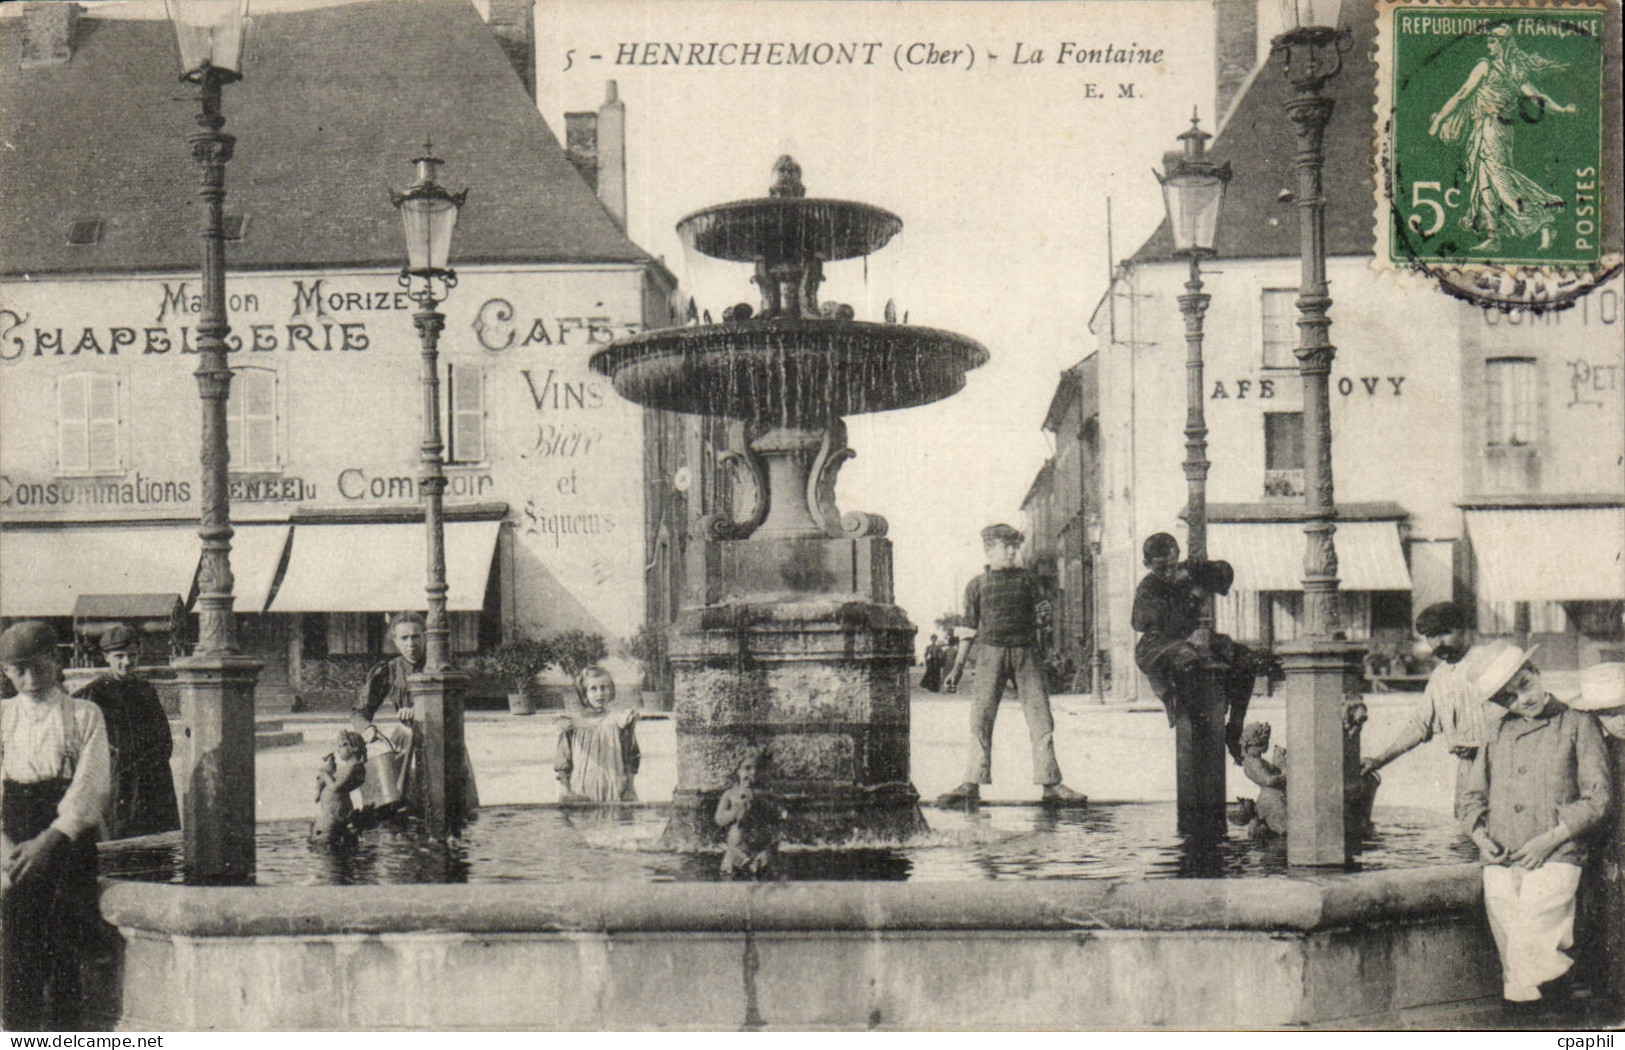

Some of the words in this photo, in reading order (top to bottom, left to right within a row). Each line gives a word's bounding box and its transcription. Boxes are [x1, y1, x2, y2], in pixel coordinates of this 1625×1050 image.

[1576, 166, 1596, 250] POSTES
[157, 281, 259, 323] Maon
[520, 369, 604, 411] VINS
[1337, 376, 1406, 397] OVY
[229, 477, 296, 500] ENEE
[338, 467, 494, 501] Comoir
[556, 467, 579, 496] et
